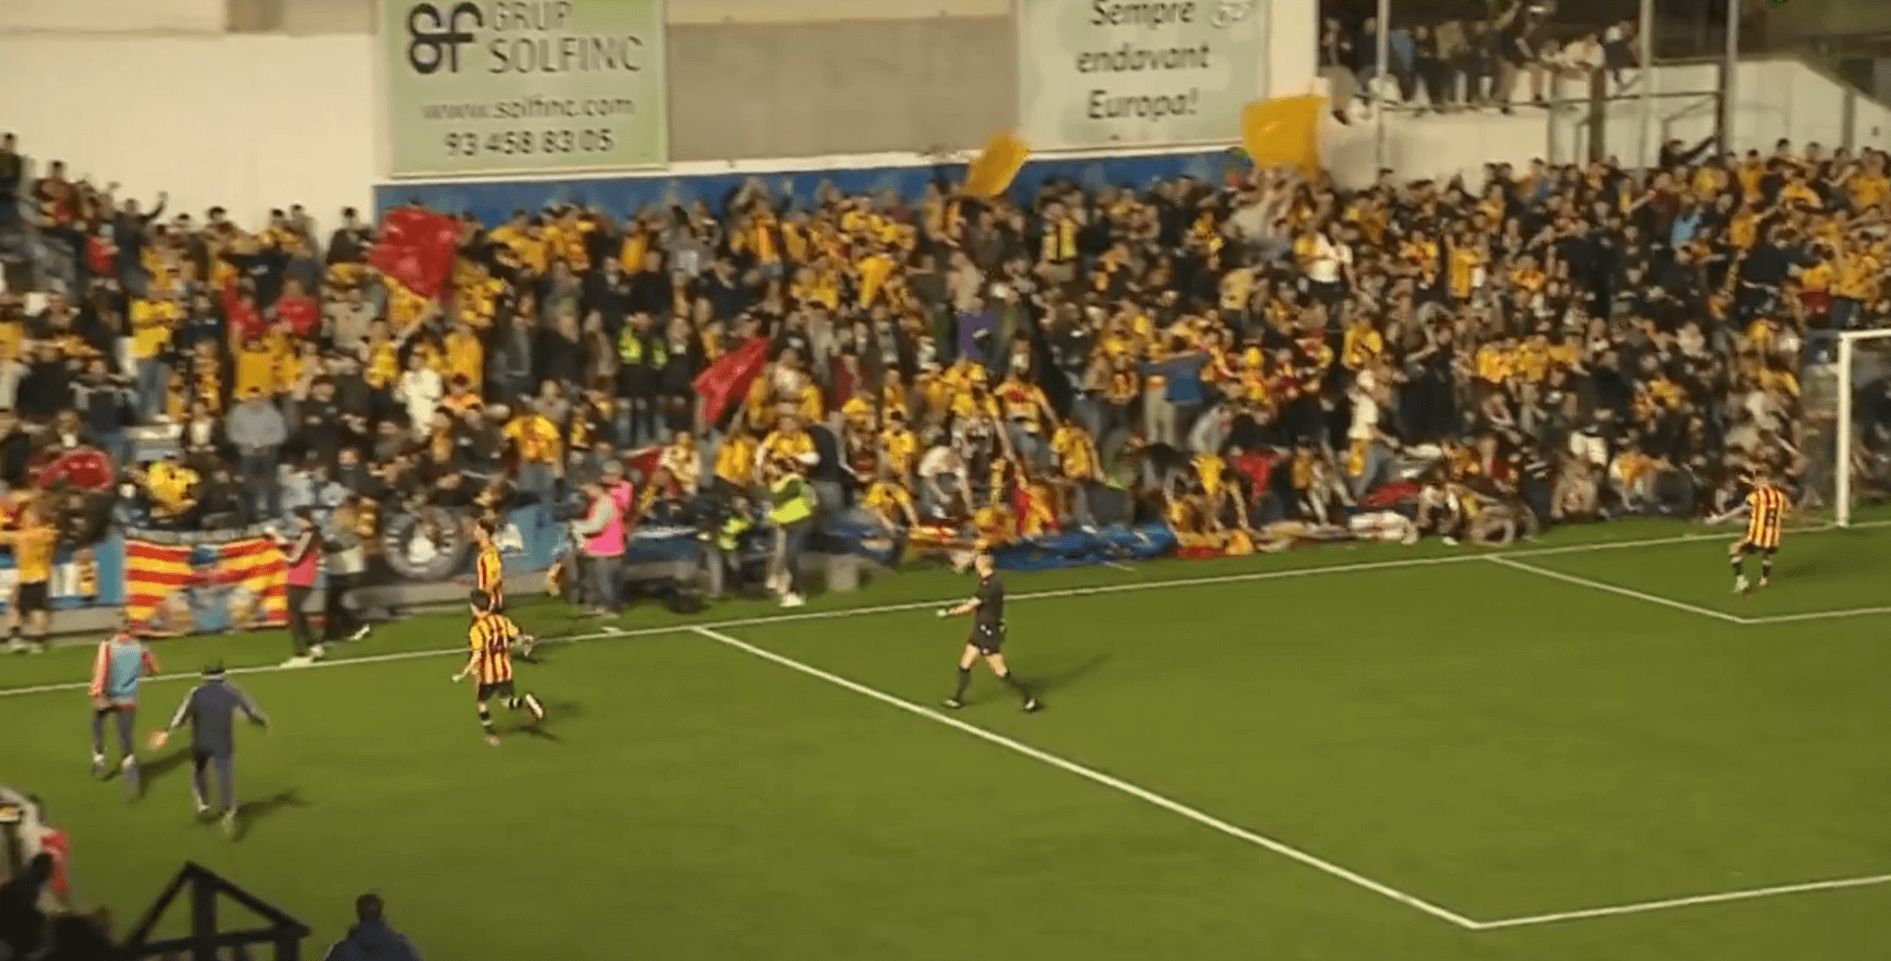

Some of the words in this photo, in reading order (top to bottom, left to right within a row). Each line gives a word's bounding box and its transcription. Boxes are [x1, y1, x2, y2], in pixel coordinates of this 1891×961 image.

[489, 1, 572, 31] GRUP
[1091, 0, 1196, 29] Sempre
[487, 36, 643, 74] SOLFINC
[1076, 43, 1209, 73] endavant
[1087, 87, 1199, 121] Europa!
[445, 132, 479, 156] 93
